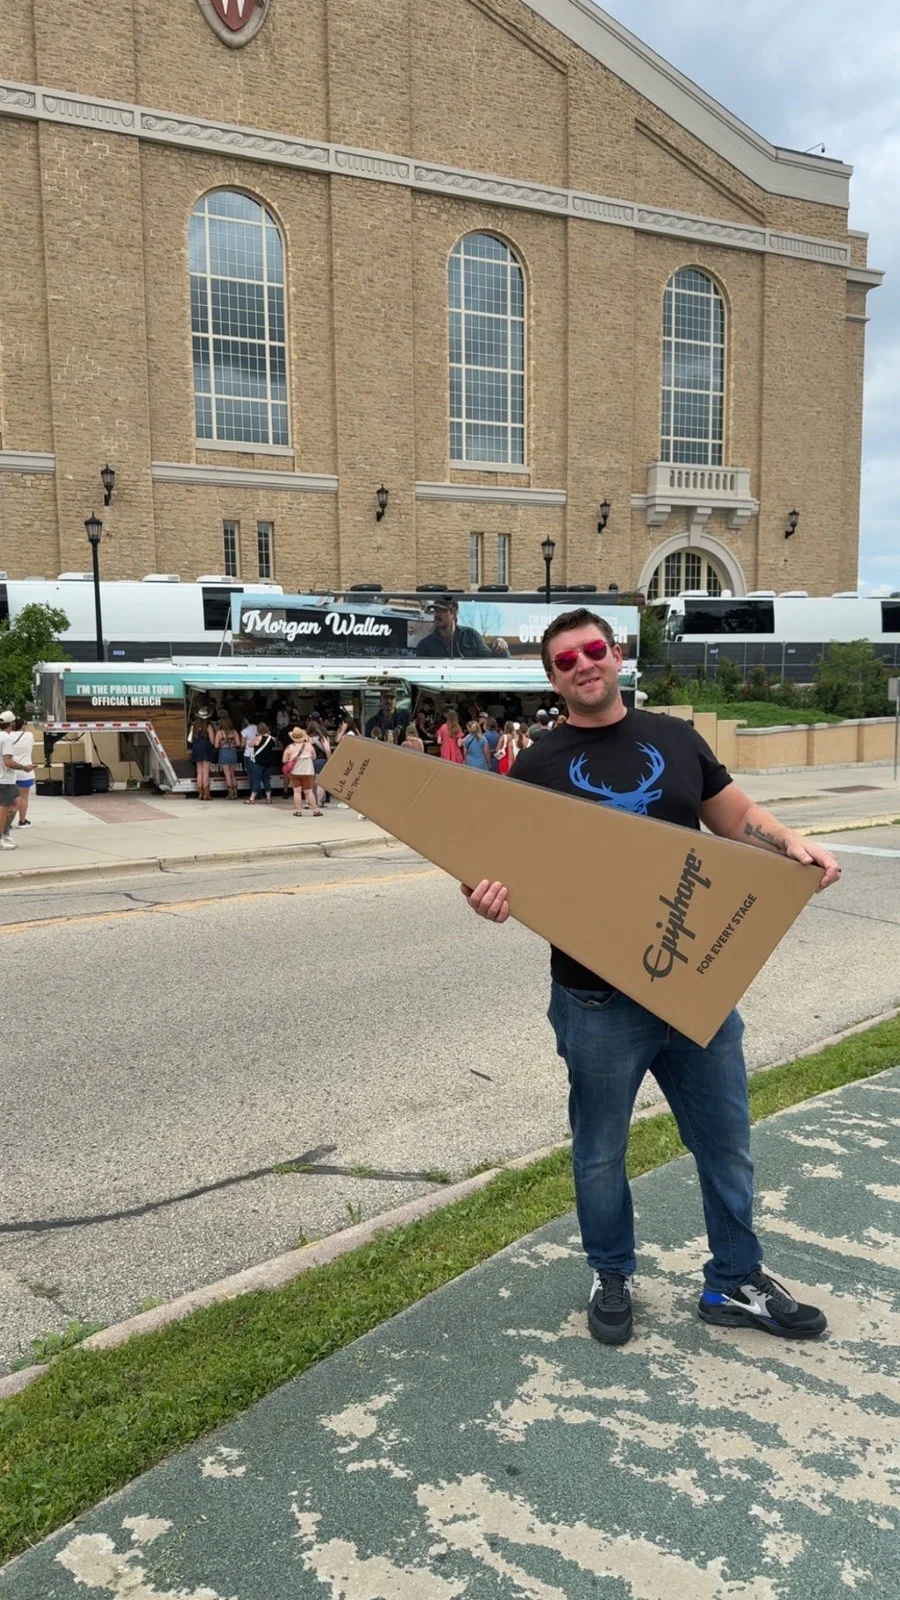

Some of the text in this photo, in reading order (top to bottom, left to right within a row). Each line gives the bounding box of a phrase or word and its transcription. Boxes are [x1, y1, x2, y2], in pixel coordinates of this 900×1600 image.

[242, 609, 393, 642] Morgan Wallen
[76, 684, 175, 694] I'M THE PROBLEM TOUR
[91, 696, 162, 706] OFFICIAL MERCH
[643, 851, 712, 983] Epiphone
[696, 893, 757, 975] FOR EVERY STAGE
